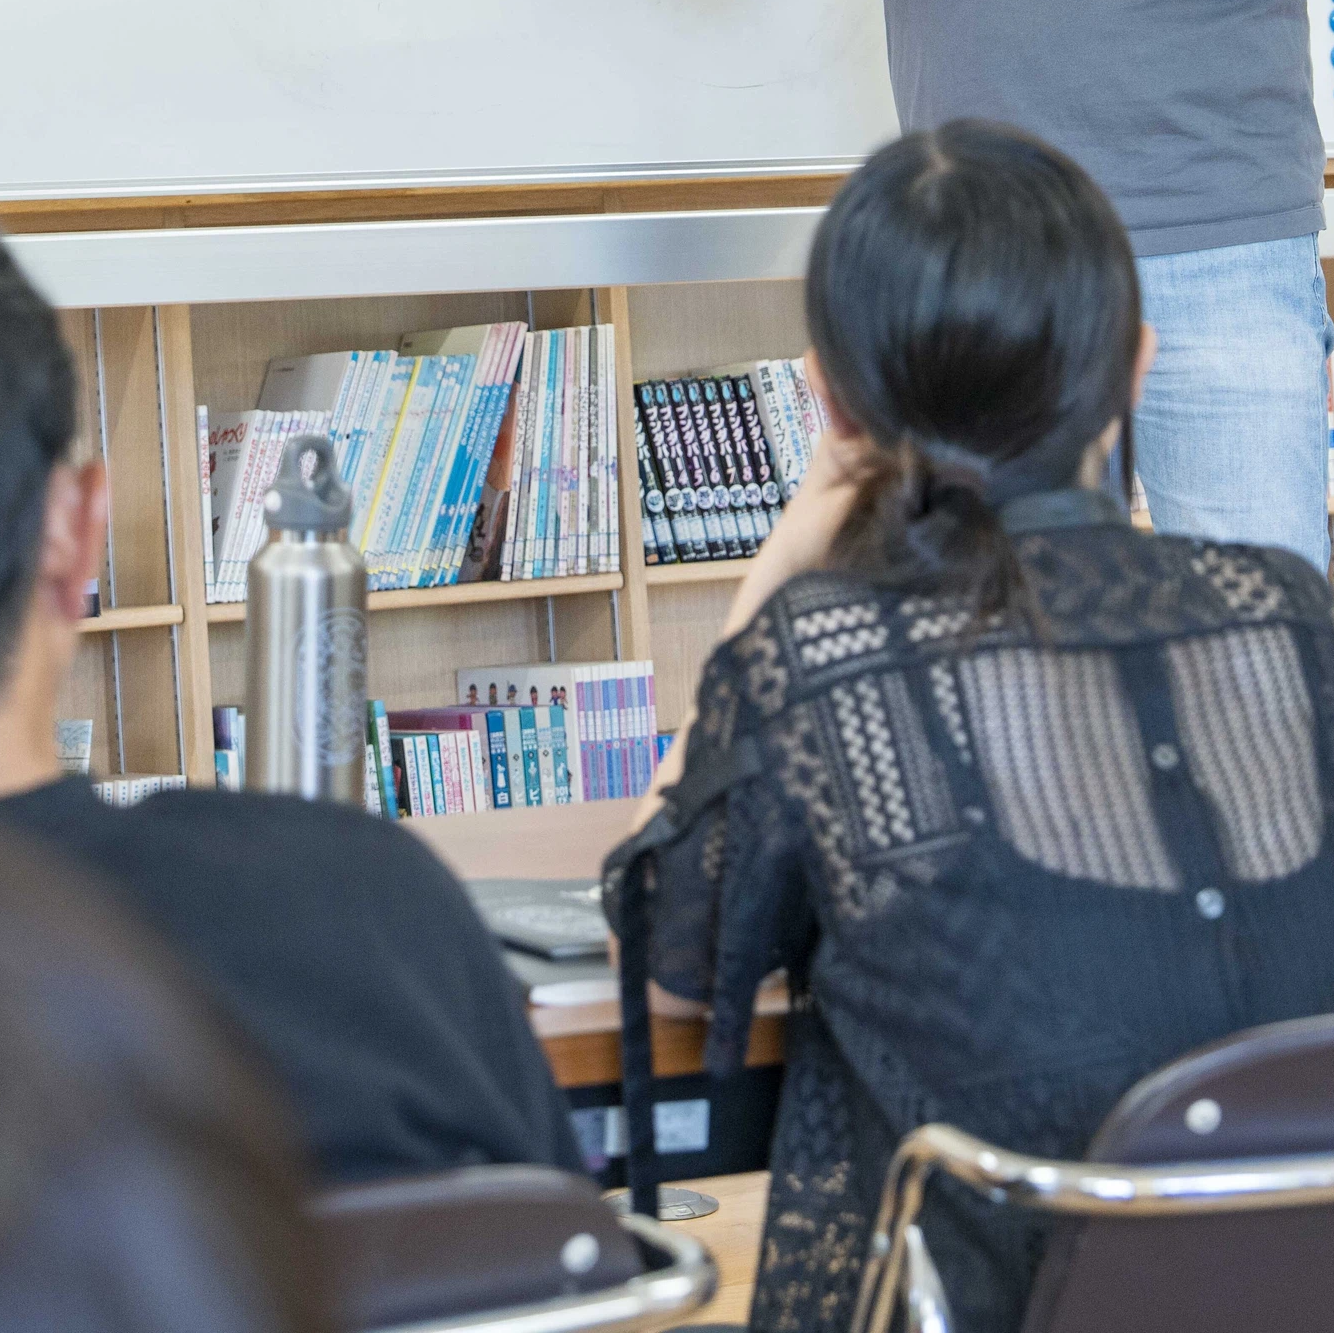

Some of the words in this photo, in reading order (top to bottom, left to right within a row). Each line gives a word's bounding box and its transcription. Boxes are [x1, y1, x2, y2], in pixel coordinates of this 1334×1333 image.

[646, 406, 670, 472] ブンダバー
[665, 471, 675, 487] 3
[660, 405, 683, 470] ブンダバー
[678, 470, 688, 485] 4
[676, 403, 700, 470] ブンダバー
[693, 470, 703, 486] 5
[692, 404, 716, 469] ブンダバー
[710, 468, 720, 484] 6
[709, 402, 732, 468] ブンダバー
[726, 467, 736, 484] 7
[725, 401, 748, 465] ブンダバー
[742, 466, 753, 482] 8
[742, 399, 767, 464] ブンダバー
[759, 464, 770, 482] 9
